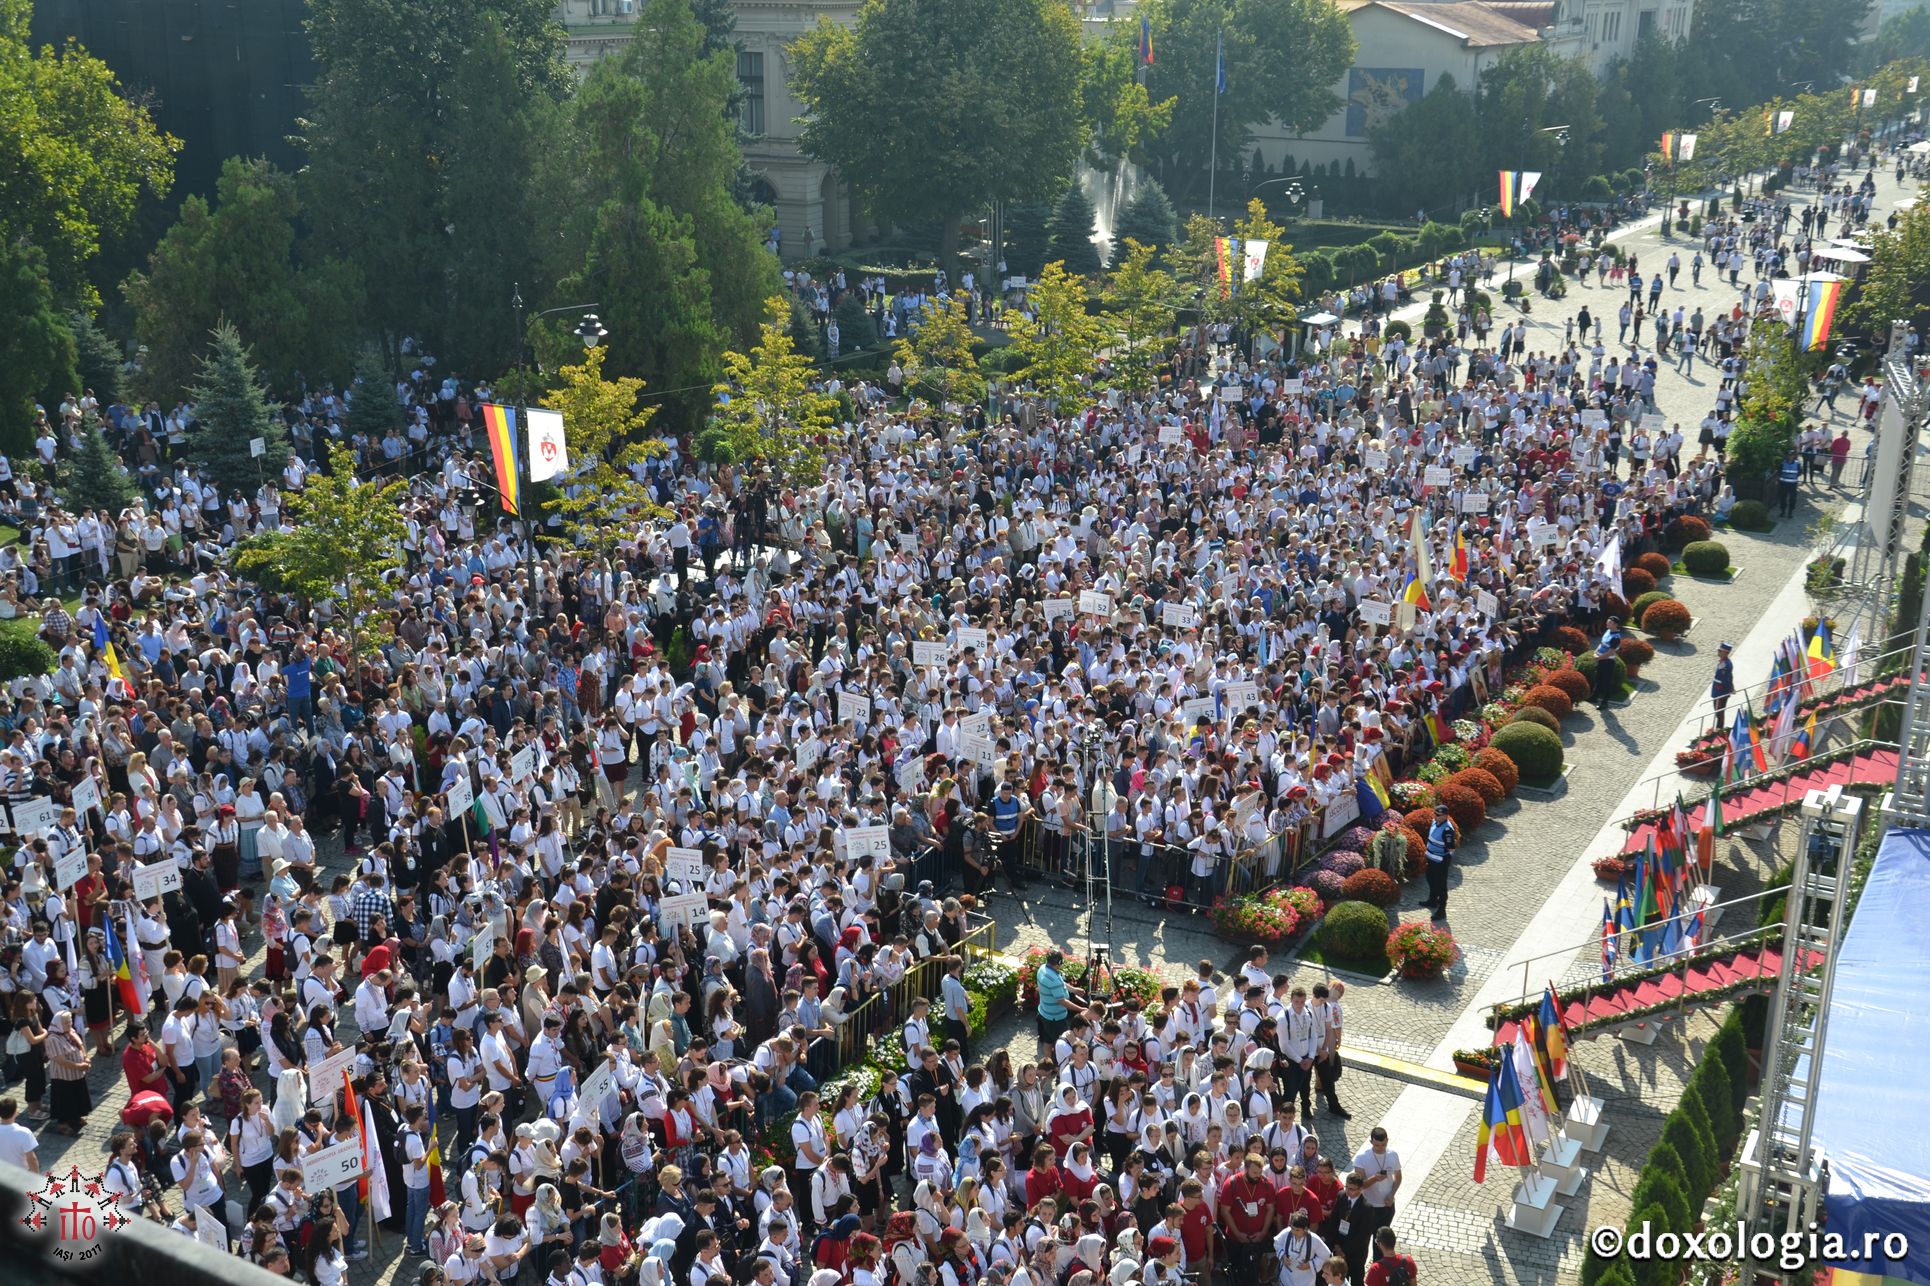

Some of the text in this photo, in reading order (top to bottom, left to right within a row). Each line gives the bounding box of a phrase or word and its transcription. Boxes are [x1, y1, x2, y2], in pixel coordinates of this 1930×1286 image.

[1548, 533, 1557, 541] 40
[1097, 603, 1107, 612] 52
[1062, 609, 1072, 618] 26
[1378, 613, 1388, 622] 43
[1181, 616, 1191, 625] 33
[976, 640, 985, 649] 26
[934, 654, 945, 662] 26
[1246, 693, 1256, 701] 43
[856, 708, 866, 718] 22
[1204, 710, 1215, 718] 52
[976, 723, 985, 733] 22
[808, 749, 815, 761] 11
[981, 751, 991, 761] 11
[524, 757, 532, 771] 05
[87, 790, 95, 802] 34
[464, 791, 472, 804] 38
[39, 811, 51, 823] 61
[874, 840, 887, 851] 25
[76, 861, 86, 874] 34
[689, 864, 700, 875] 25
[163, 873, 177, 886] 34
[691, 906, 706, 918] 14
[599, 1078, 609, 1095] 55
[341, 1157, 358, 1173] 50
